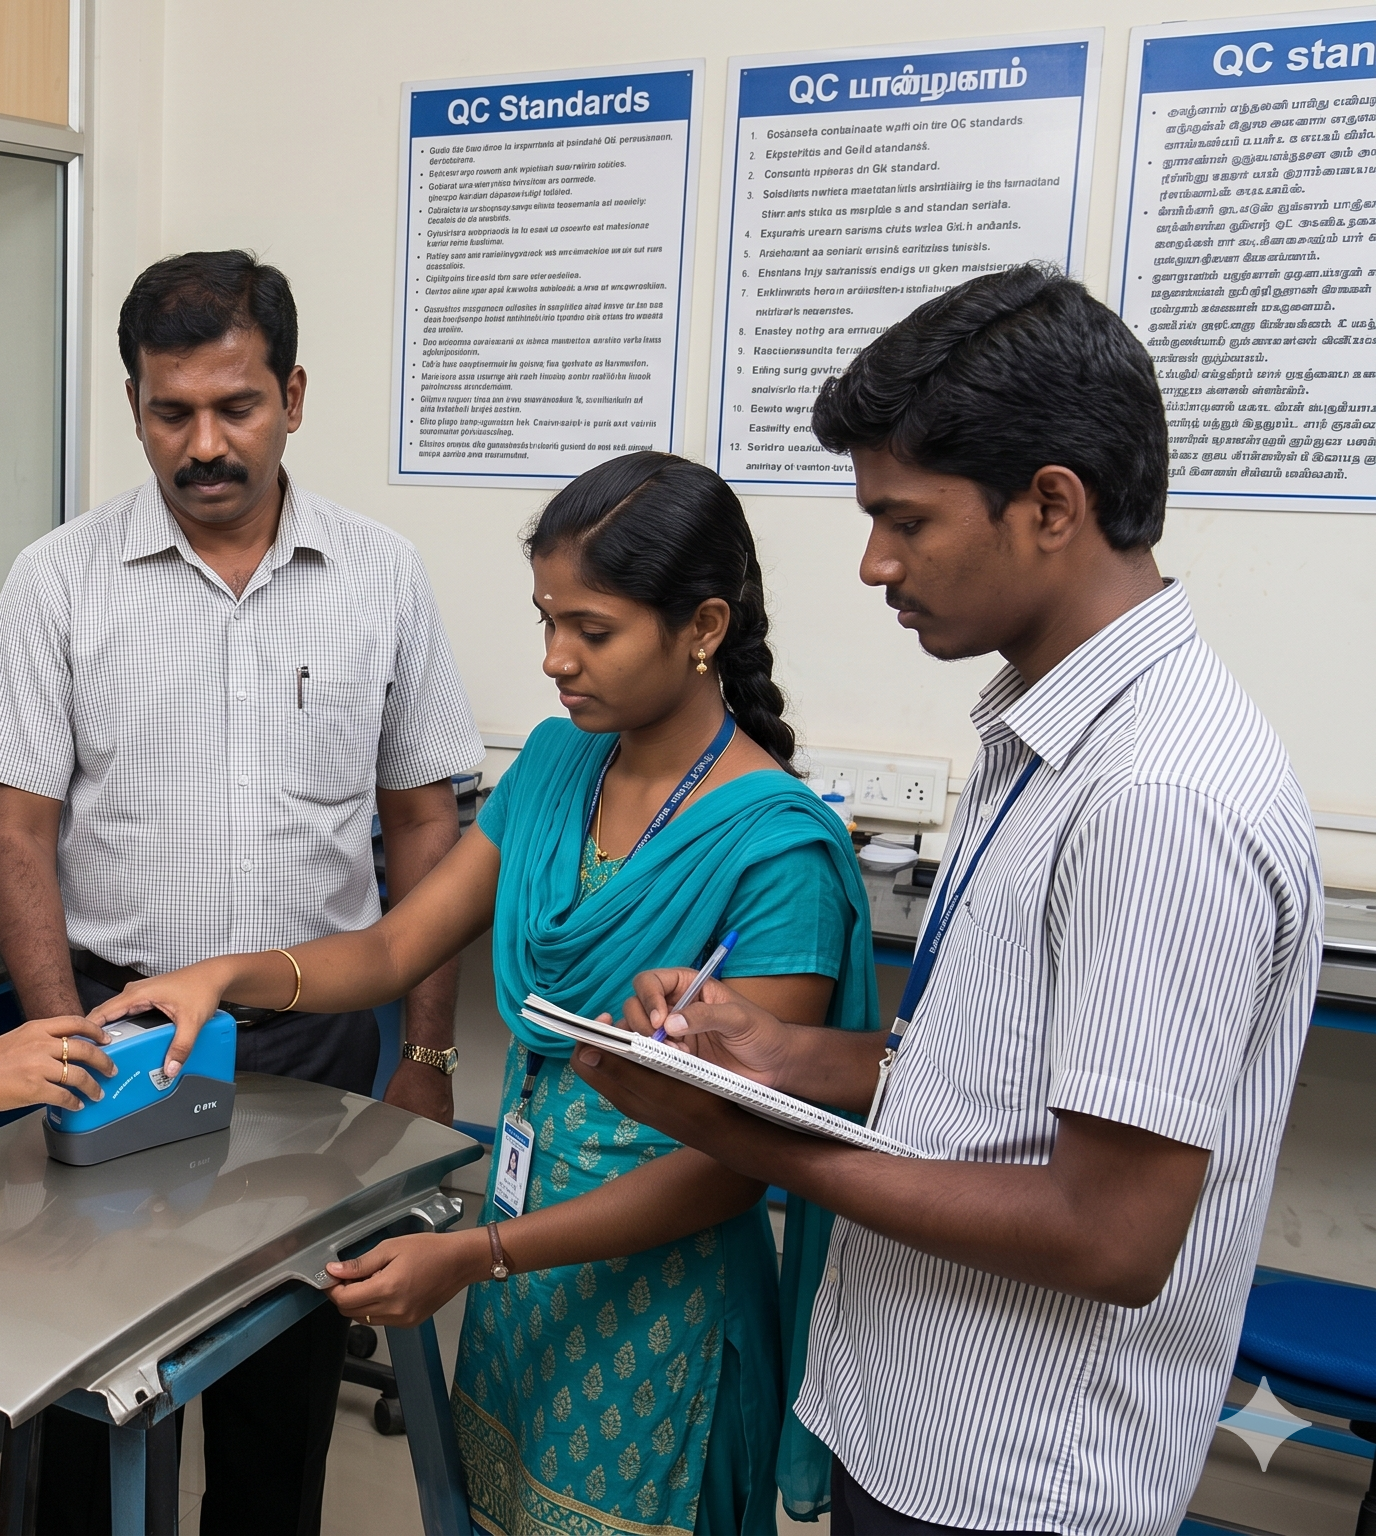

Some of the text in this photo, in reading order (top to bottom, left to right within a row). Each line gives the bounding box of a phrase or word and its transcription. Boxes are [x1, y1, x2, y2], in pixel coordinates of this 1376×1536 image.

[1213, 41, 1274, 77] QC
[788, 73, 840, 105] QC
[447, 86, 650, 126] QC Standards
[749, 151, 756, 160] 2.
[824, 146, 842, 156] and
[748, 172, 755, 180] 2.
[891, 161, 940, 173] standard.
[904, 203, 923, 213] and
[927, 202, 968, 212] standan
[743, 250, 751, 258] 5.
[742, 270, 749, 278] 6.
[739, 328, 746, 336] 8.
[733, 405, 744, 413] 10.
[730, 443, 742, 451] 13.
